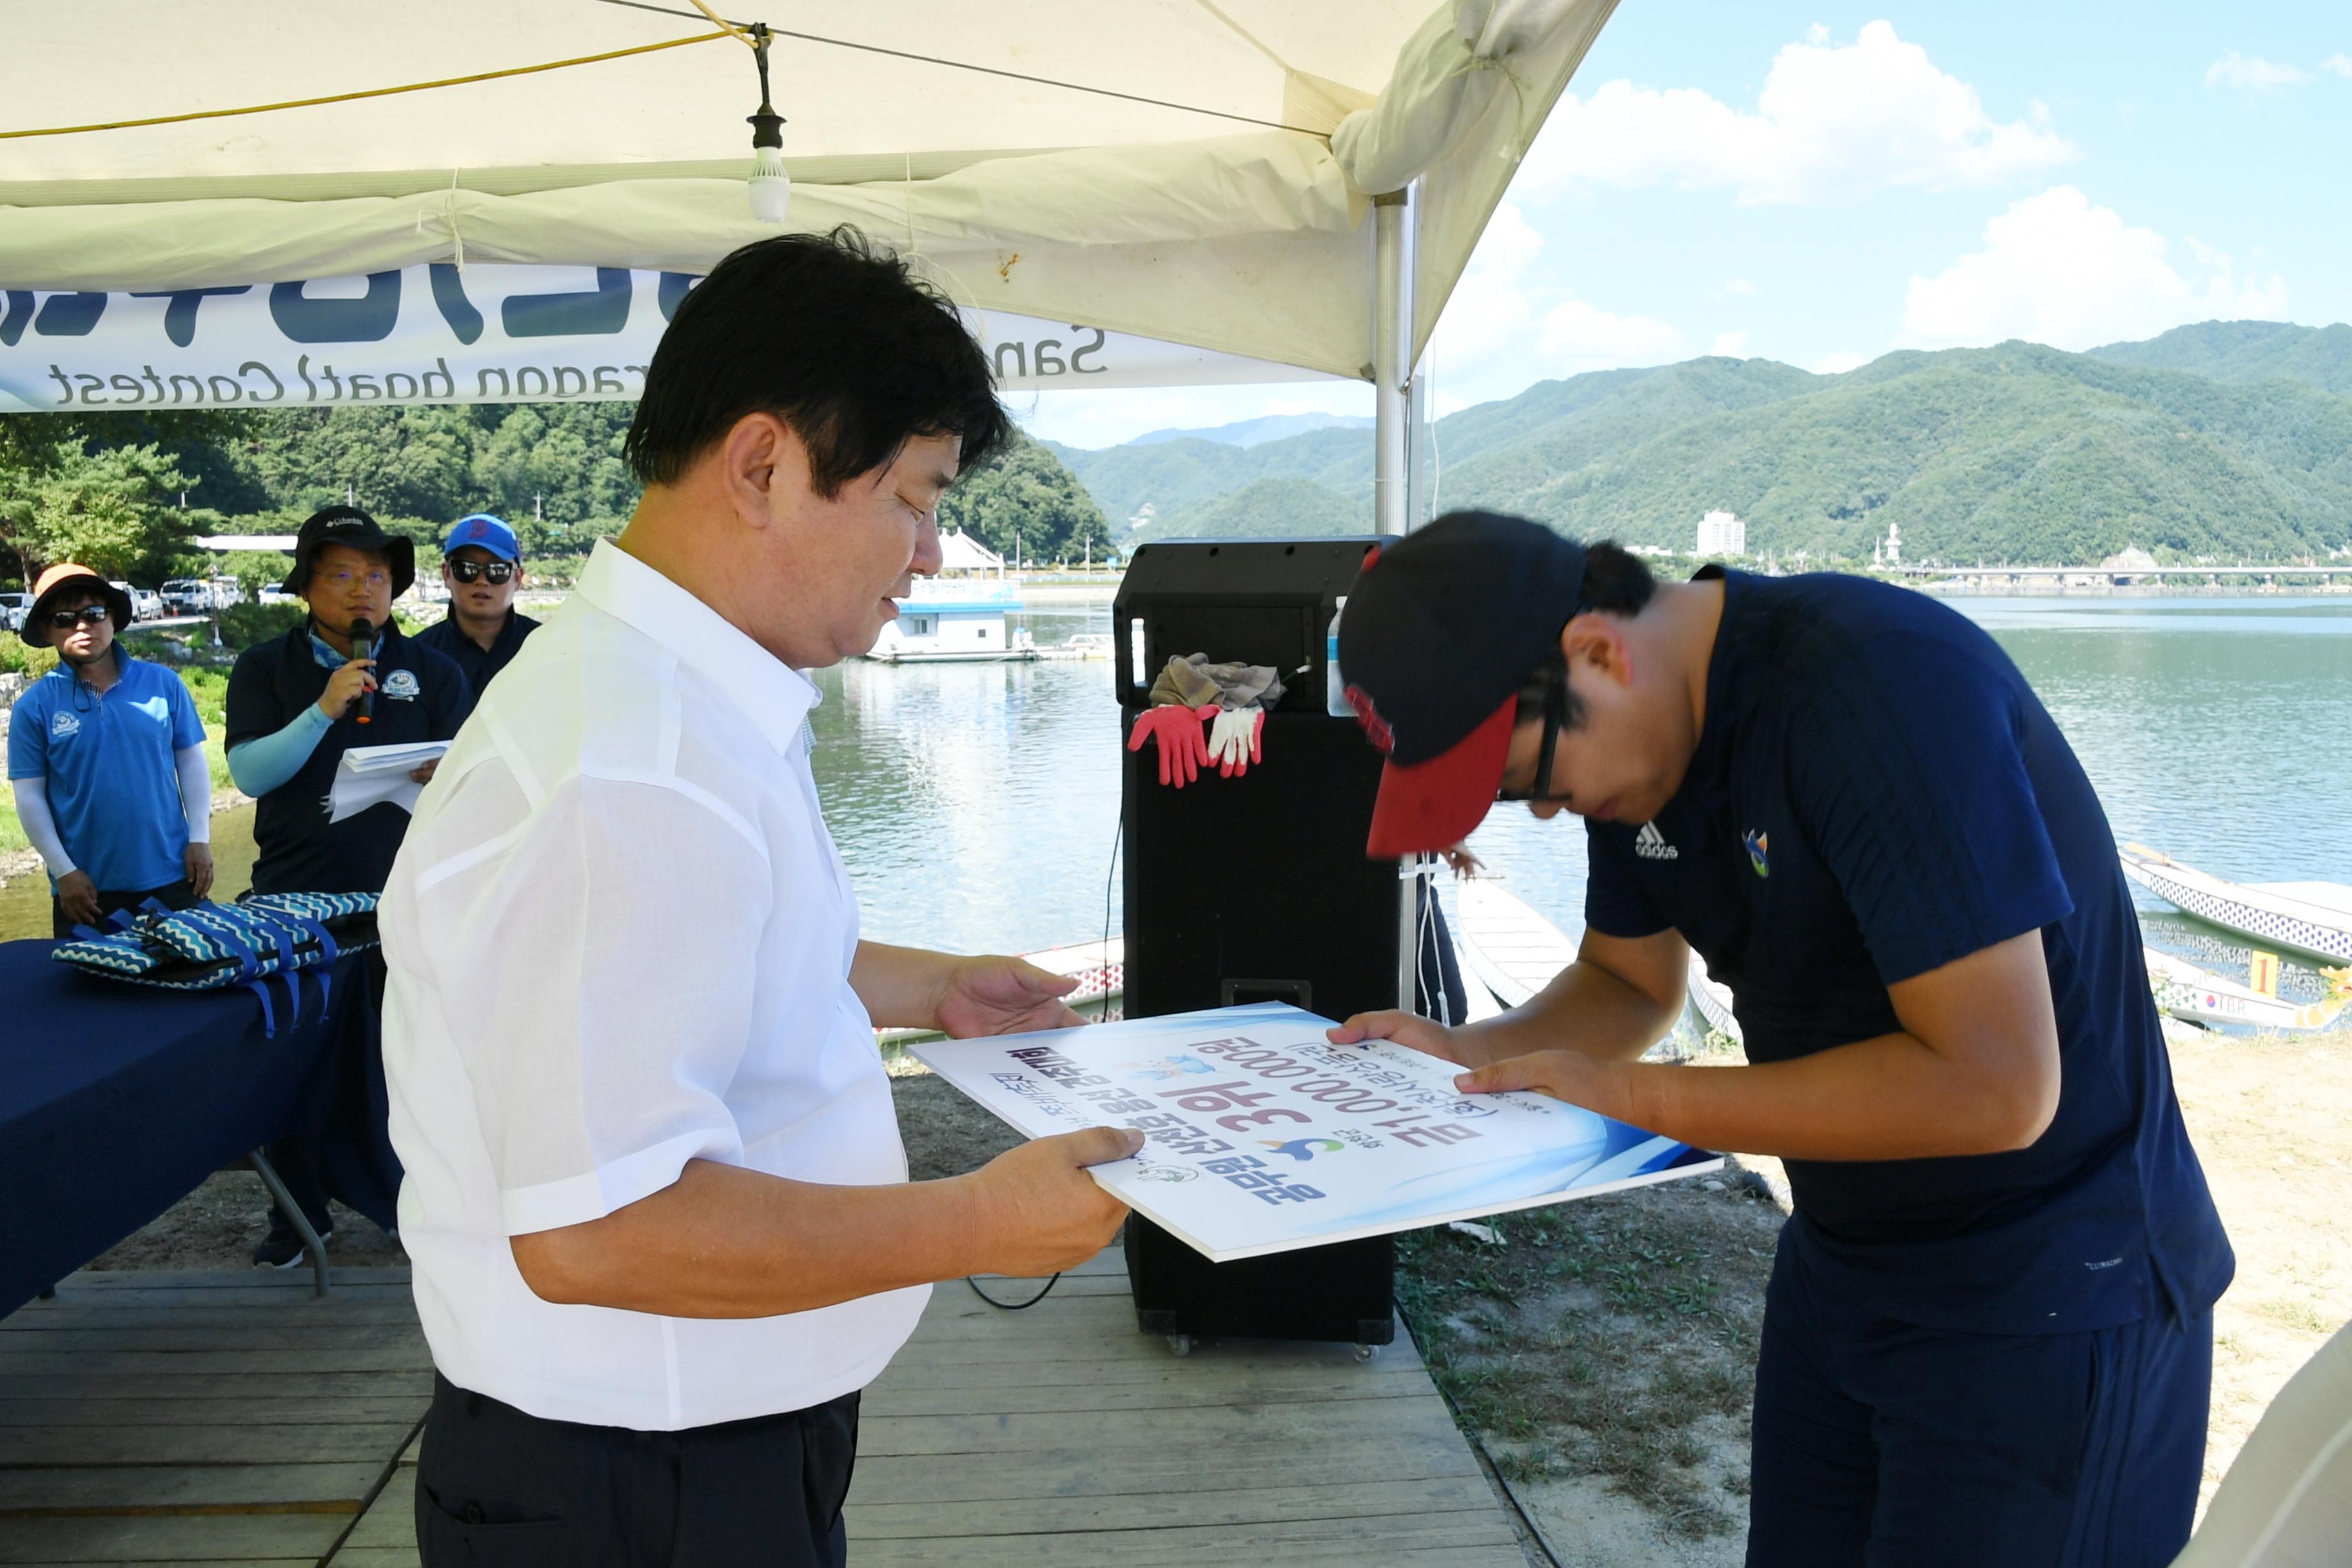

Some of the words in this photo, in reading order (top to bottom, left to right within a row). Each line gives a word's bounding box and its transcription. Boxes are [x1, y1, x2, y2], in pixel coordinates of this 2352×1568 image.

[1635, 841, 1678, 860] adidas
[2257, 958, 2269, 995] 1
[1004, 1046, 1111, 1090] 경주대회
[1077, 1087, 1158, 1114] 용선
[1153, 1081, 1312, 1132] 3위
[1188, 1036, 1483, 1148] 금1,000,000원
[1331, 1128, 1384, 1150] 화천군
[1196, 1154, 1326, 1205] 공무원
